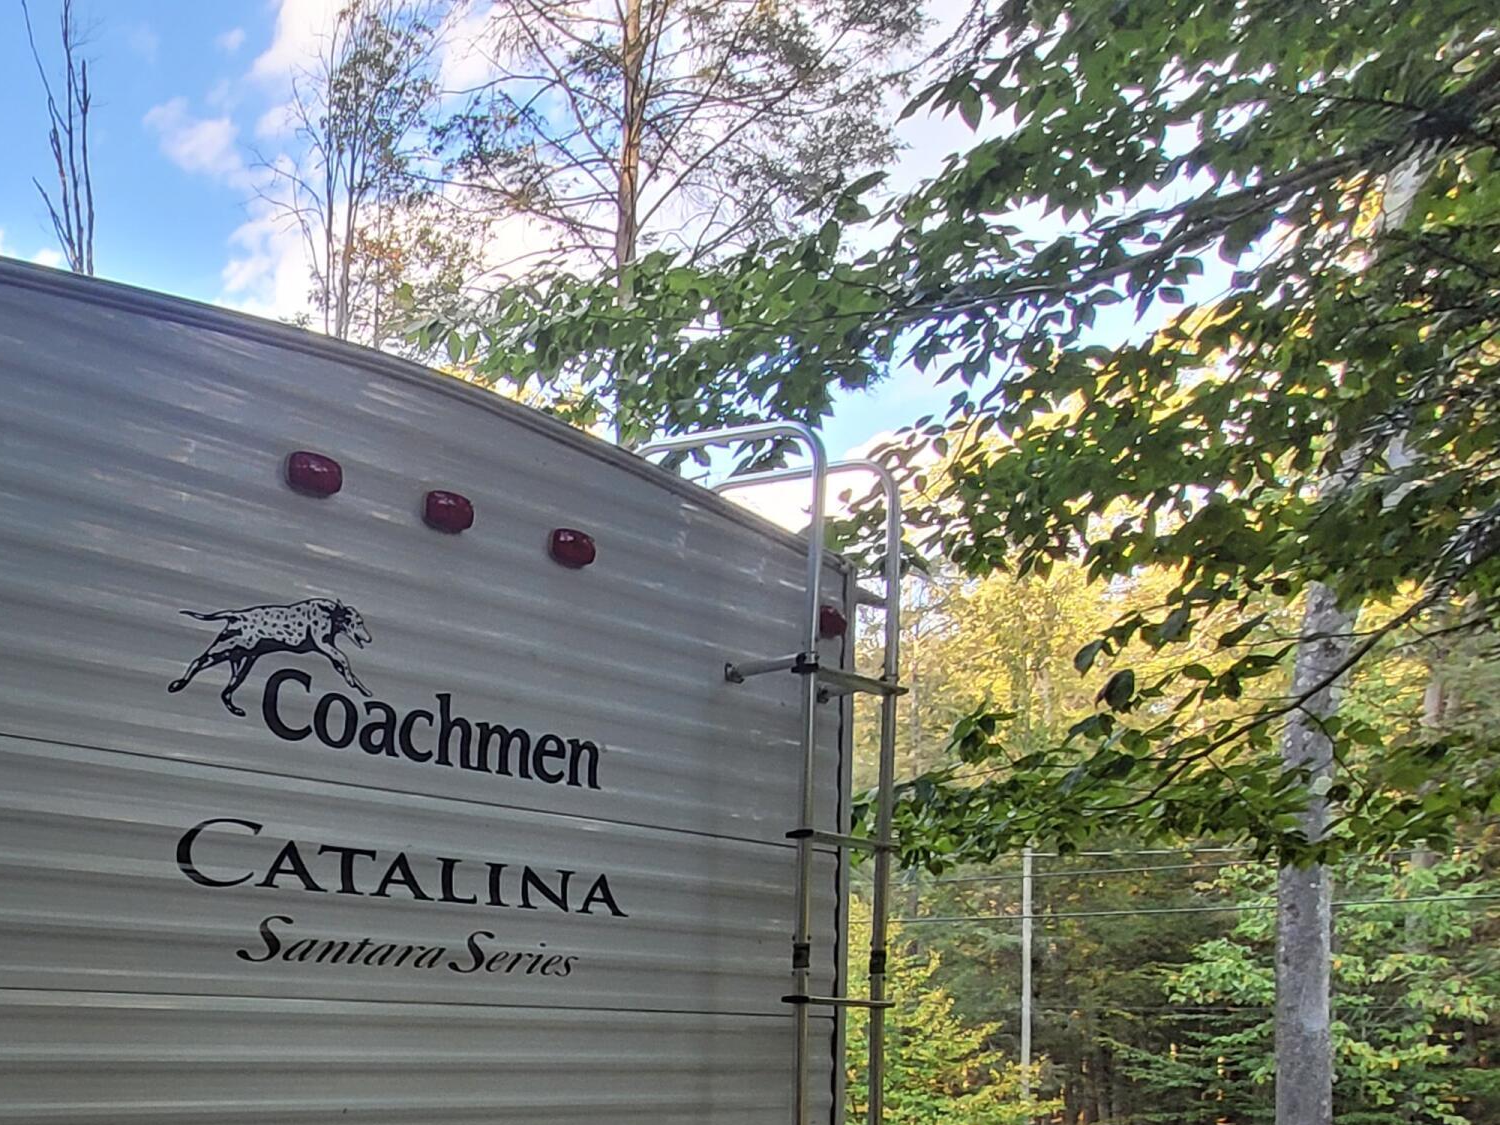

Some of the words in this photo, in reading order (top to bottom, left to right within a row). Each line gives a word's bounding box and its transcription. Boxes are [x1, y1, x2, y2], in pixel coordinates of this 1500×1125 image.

[262, 668, 601, 789] Coachmen
[176, 818, 628, 917] CATALINA
[236, 915, 443, 969] Santara
[448, 930, 578, 977] Series
